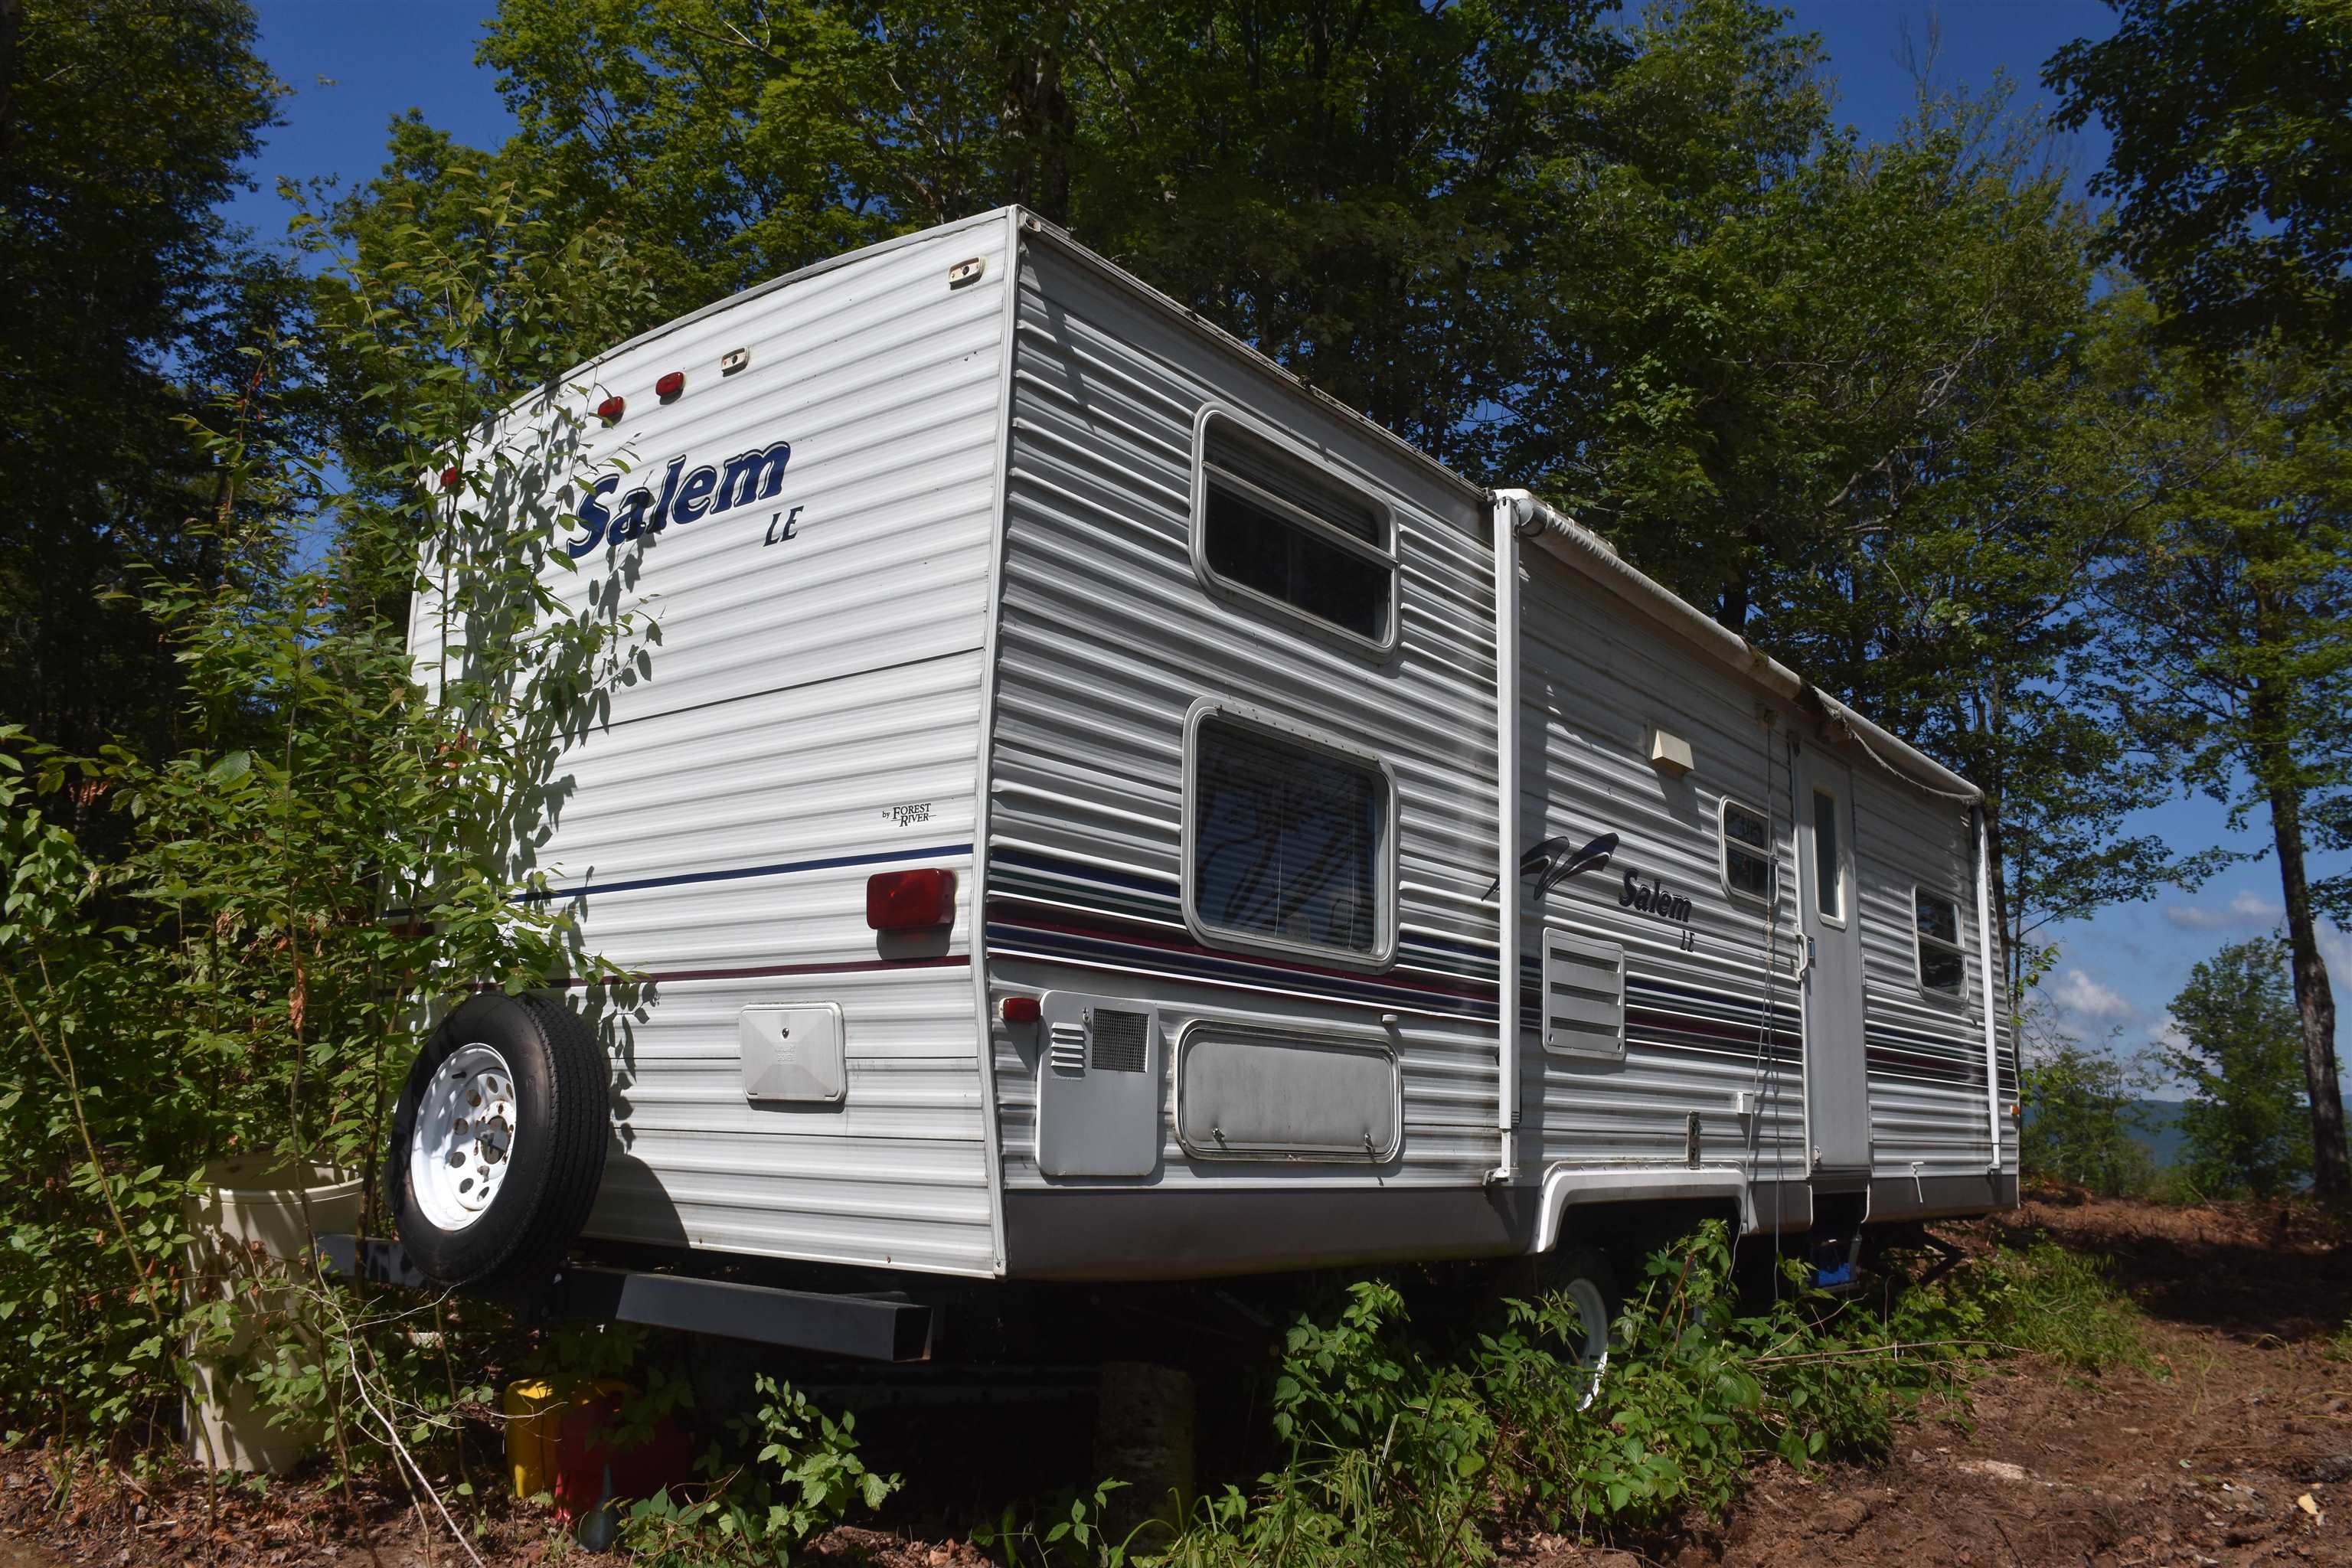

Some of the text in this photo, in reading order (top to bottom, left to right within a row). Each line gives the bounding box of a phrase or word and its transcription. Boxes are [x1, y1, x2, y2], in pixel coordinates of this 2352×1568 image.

[566, 440, 791, 560] Salem
[763, 505, 805, 547] LE
[882, 802, 932, 820] by FOREST
[899, 812, 929, 828] RIVER
[1618, 867, 1692, 923] Salem
[1680, 929, 1696, 953] LE
